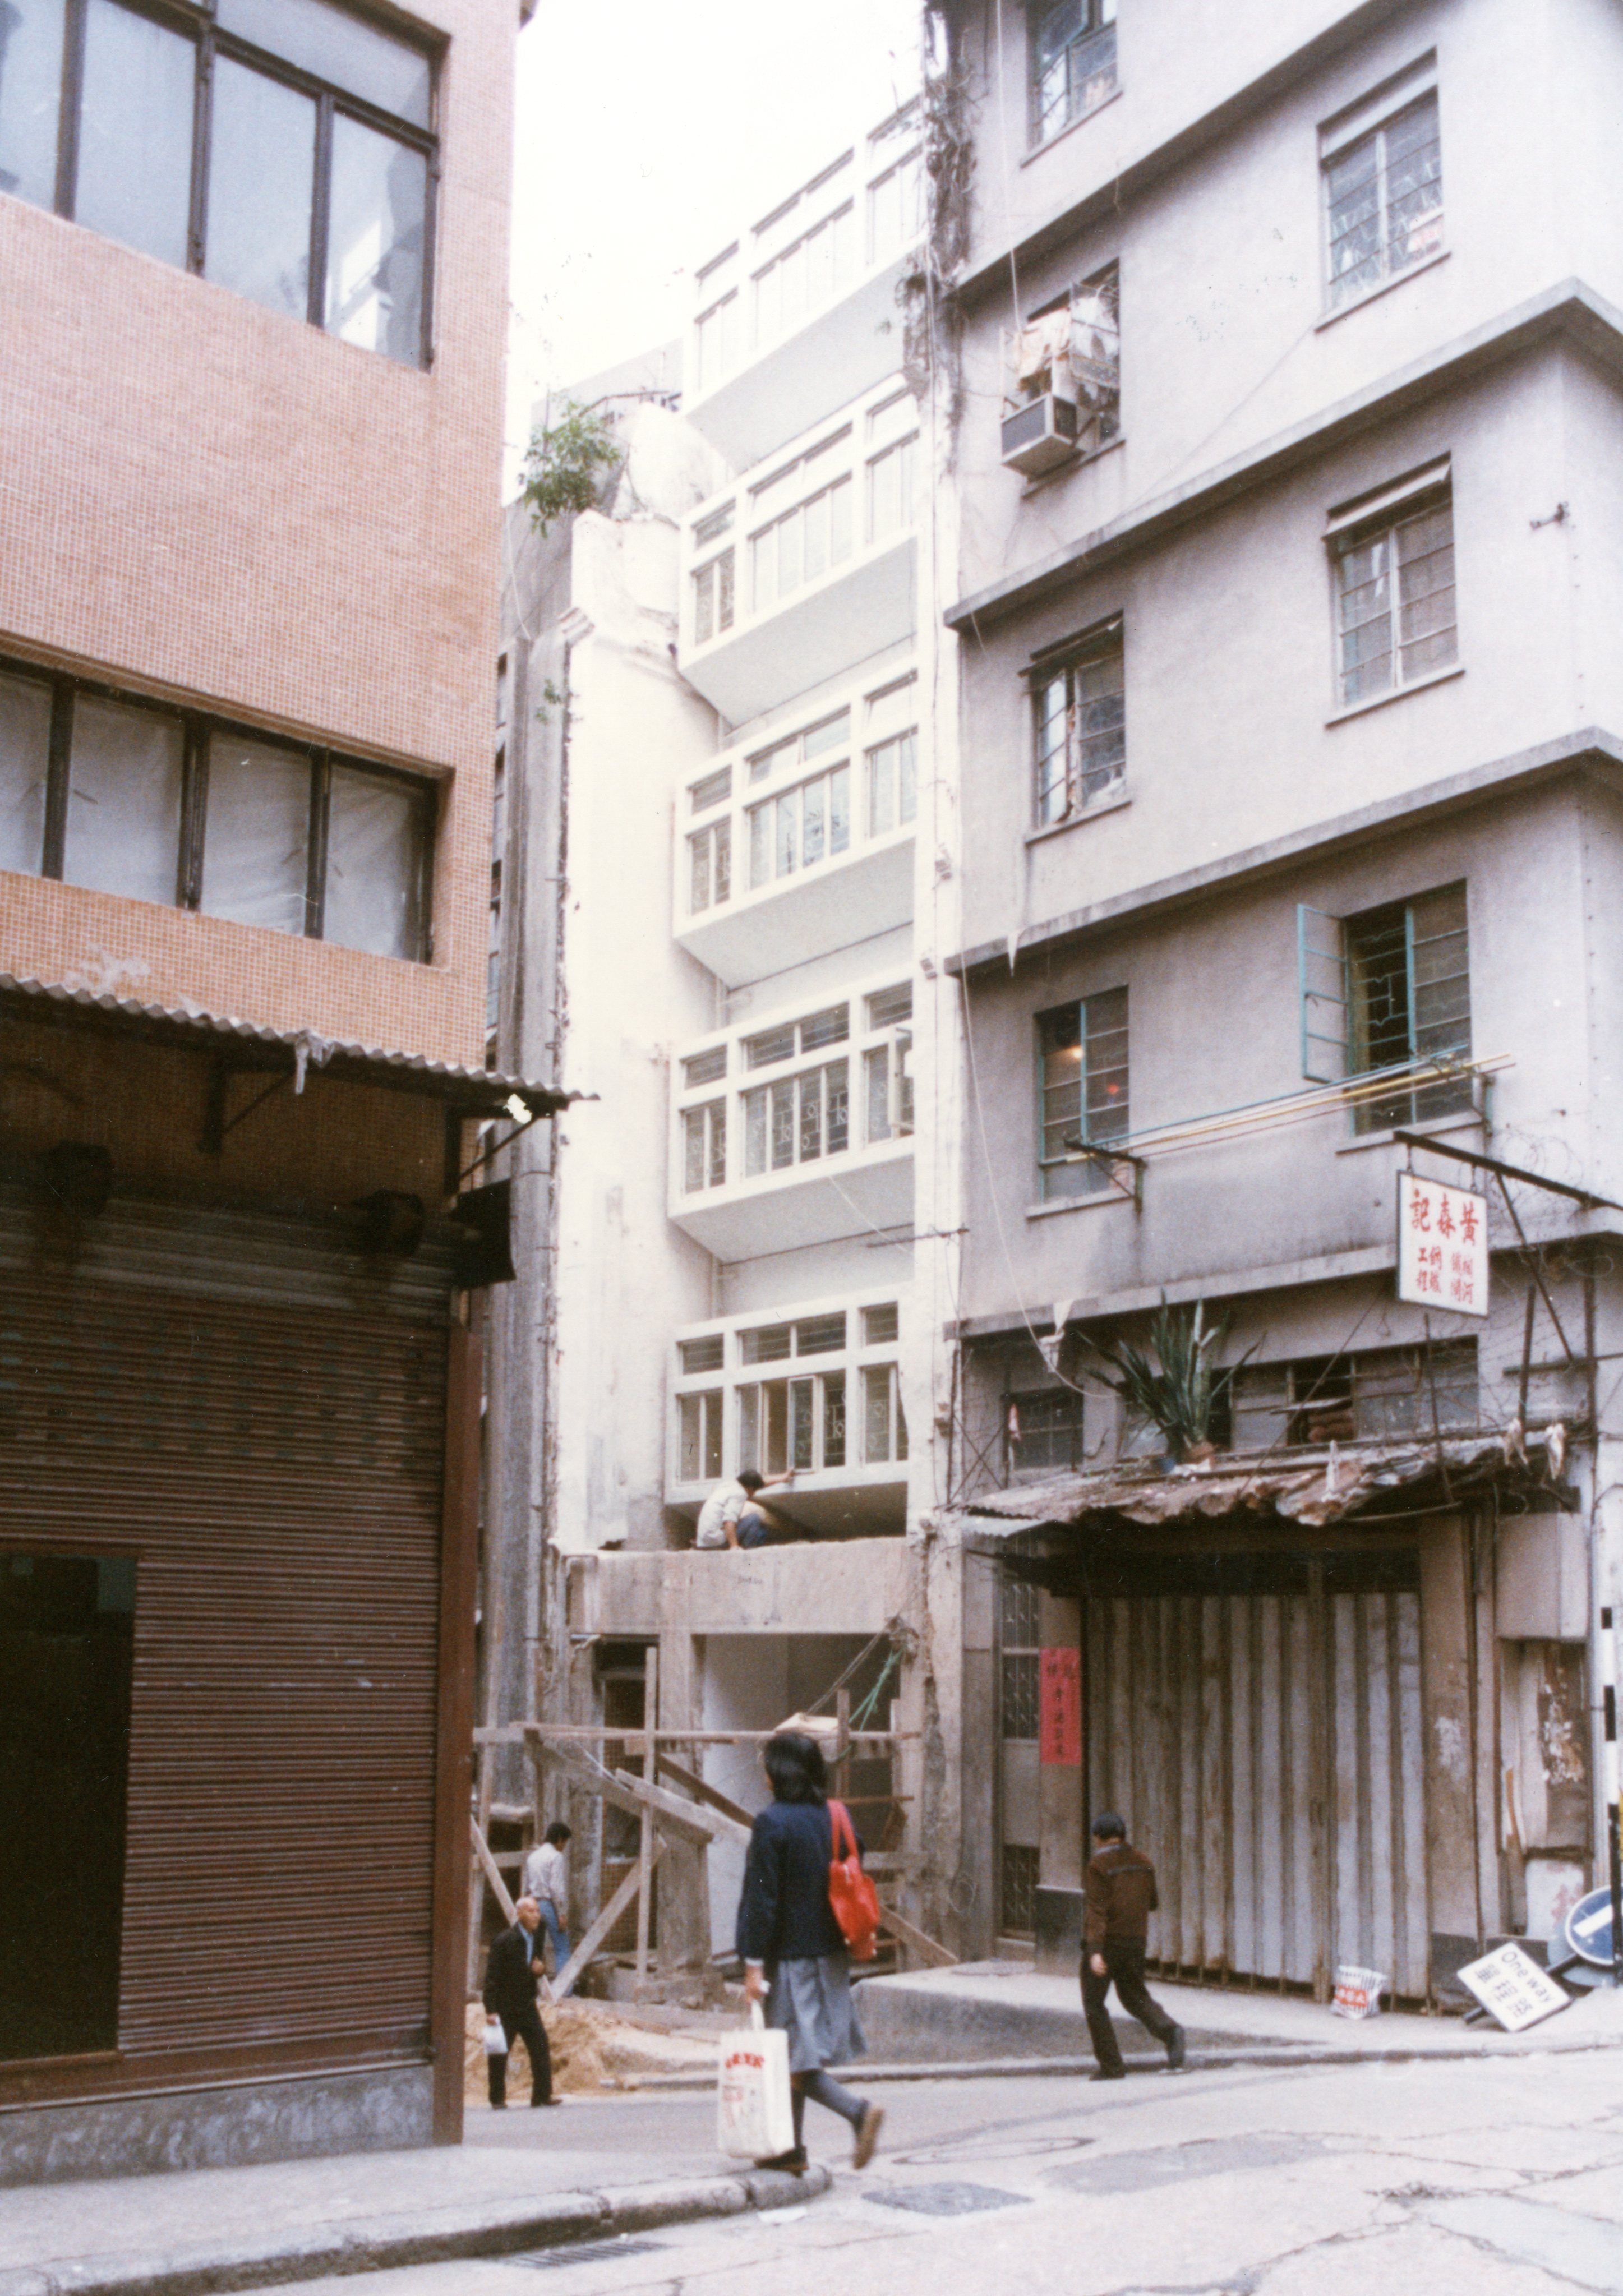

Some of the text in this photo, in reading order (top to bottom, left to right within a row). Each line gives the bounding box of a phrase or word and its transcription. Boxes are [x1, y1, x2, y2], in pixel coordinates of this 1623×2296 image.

[1409, 1188, 1479, 1246] 黃森記
[1474, 1963, 1534, 2017] 單程路
[1501, 1951, 1553, 2003] One way
